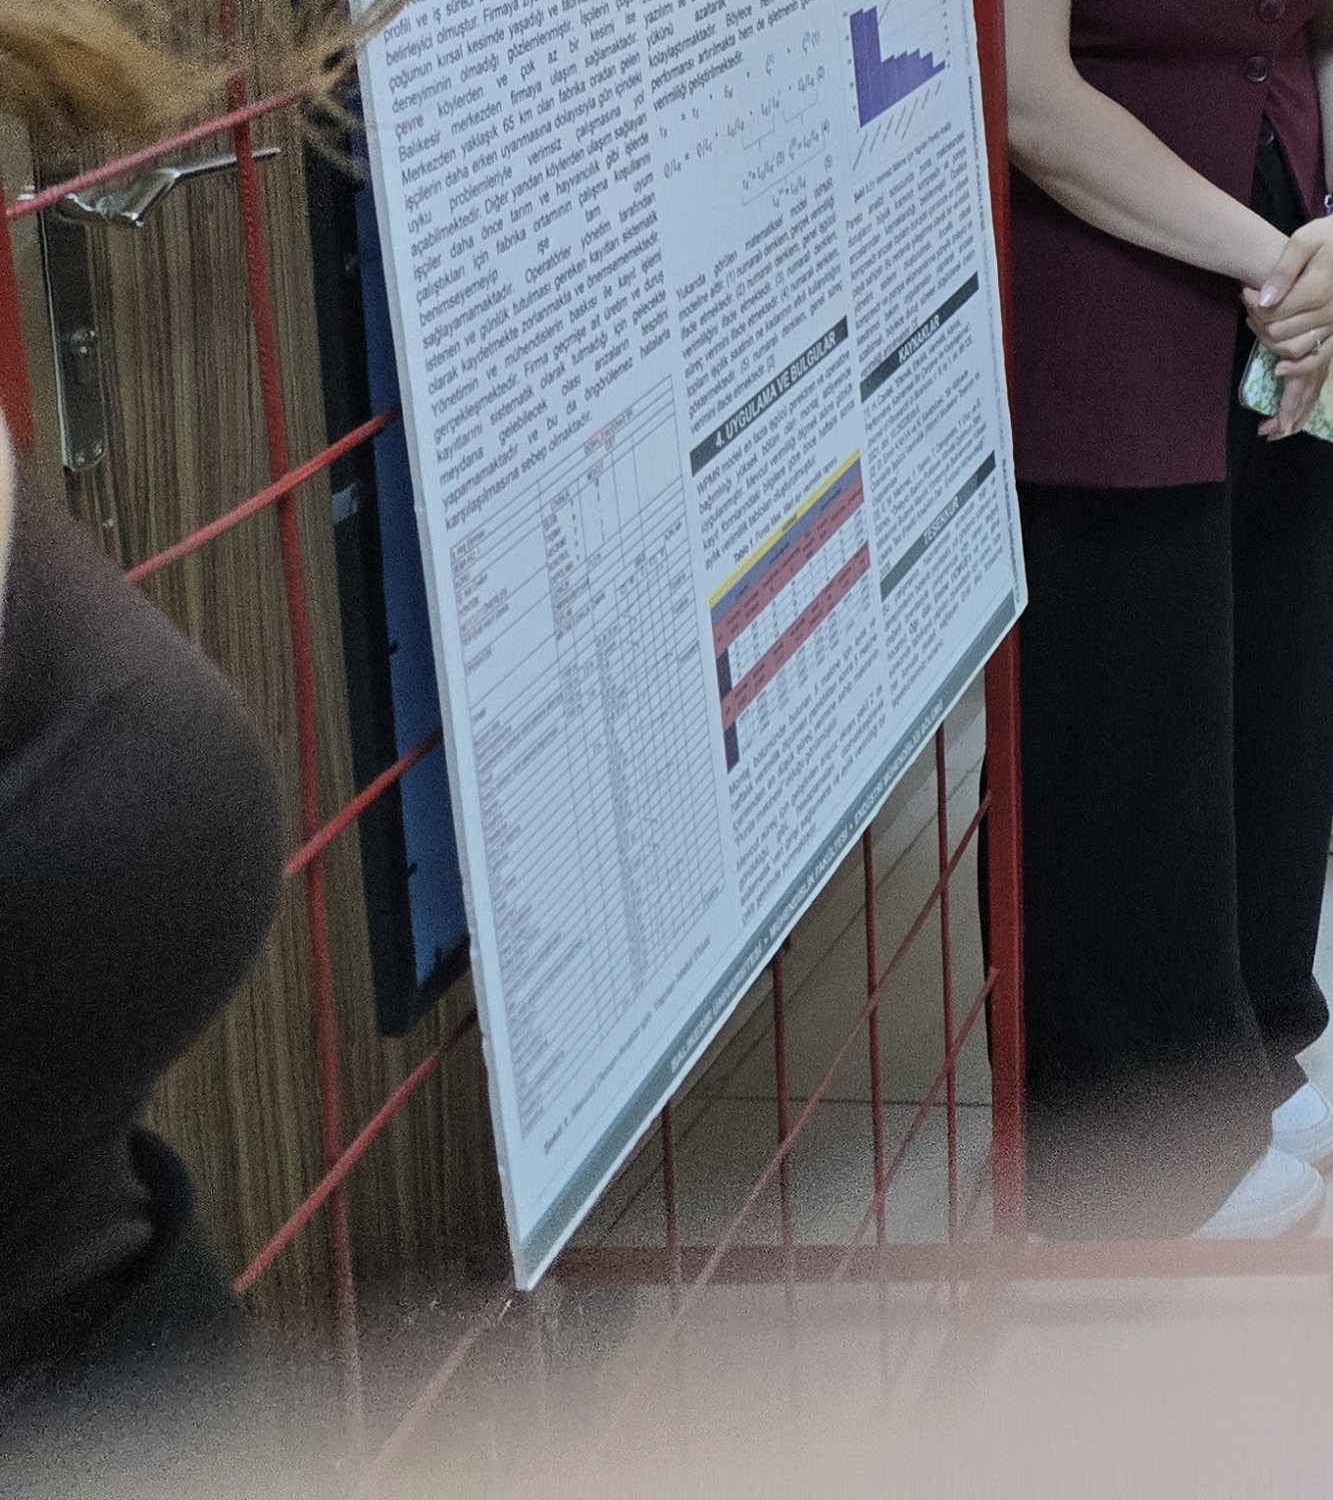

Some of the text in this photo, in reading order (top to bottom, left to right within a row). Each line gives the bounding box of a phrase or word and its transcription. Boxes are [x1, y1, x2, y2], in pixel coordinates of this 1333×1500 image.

[395, 9, 636, 142] çevre köylerden ve çok az bir kesimi ise
[398, 125, 442, 163] Balıkesir
[450, 96, 502, 137] merkezden
[510, 75, 542, 109] firmaya
[549, 59, 577, 89] ulaşım
[401, 48, 640, 187] Merkezden yaklaşık 65 km olan fabrika oradan gelen
[407, 88, 645, 237] uyku problemleriyle verimsiz çalışmasına yol
[715, 329, 835, 450] 4. UYGULAMA VE BULGULAR
[898, 312, 939, 364] KAYNAKLAR
[445, 406, 591, 536] karşılaşılmasına sebep olmaktadır.
